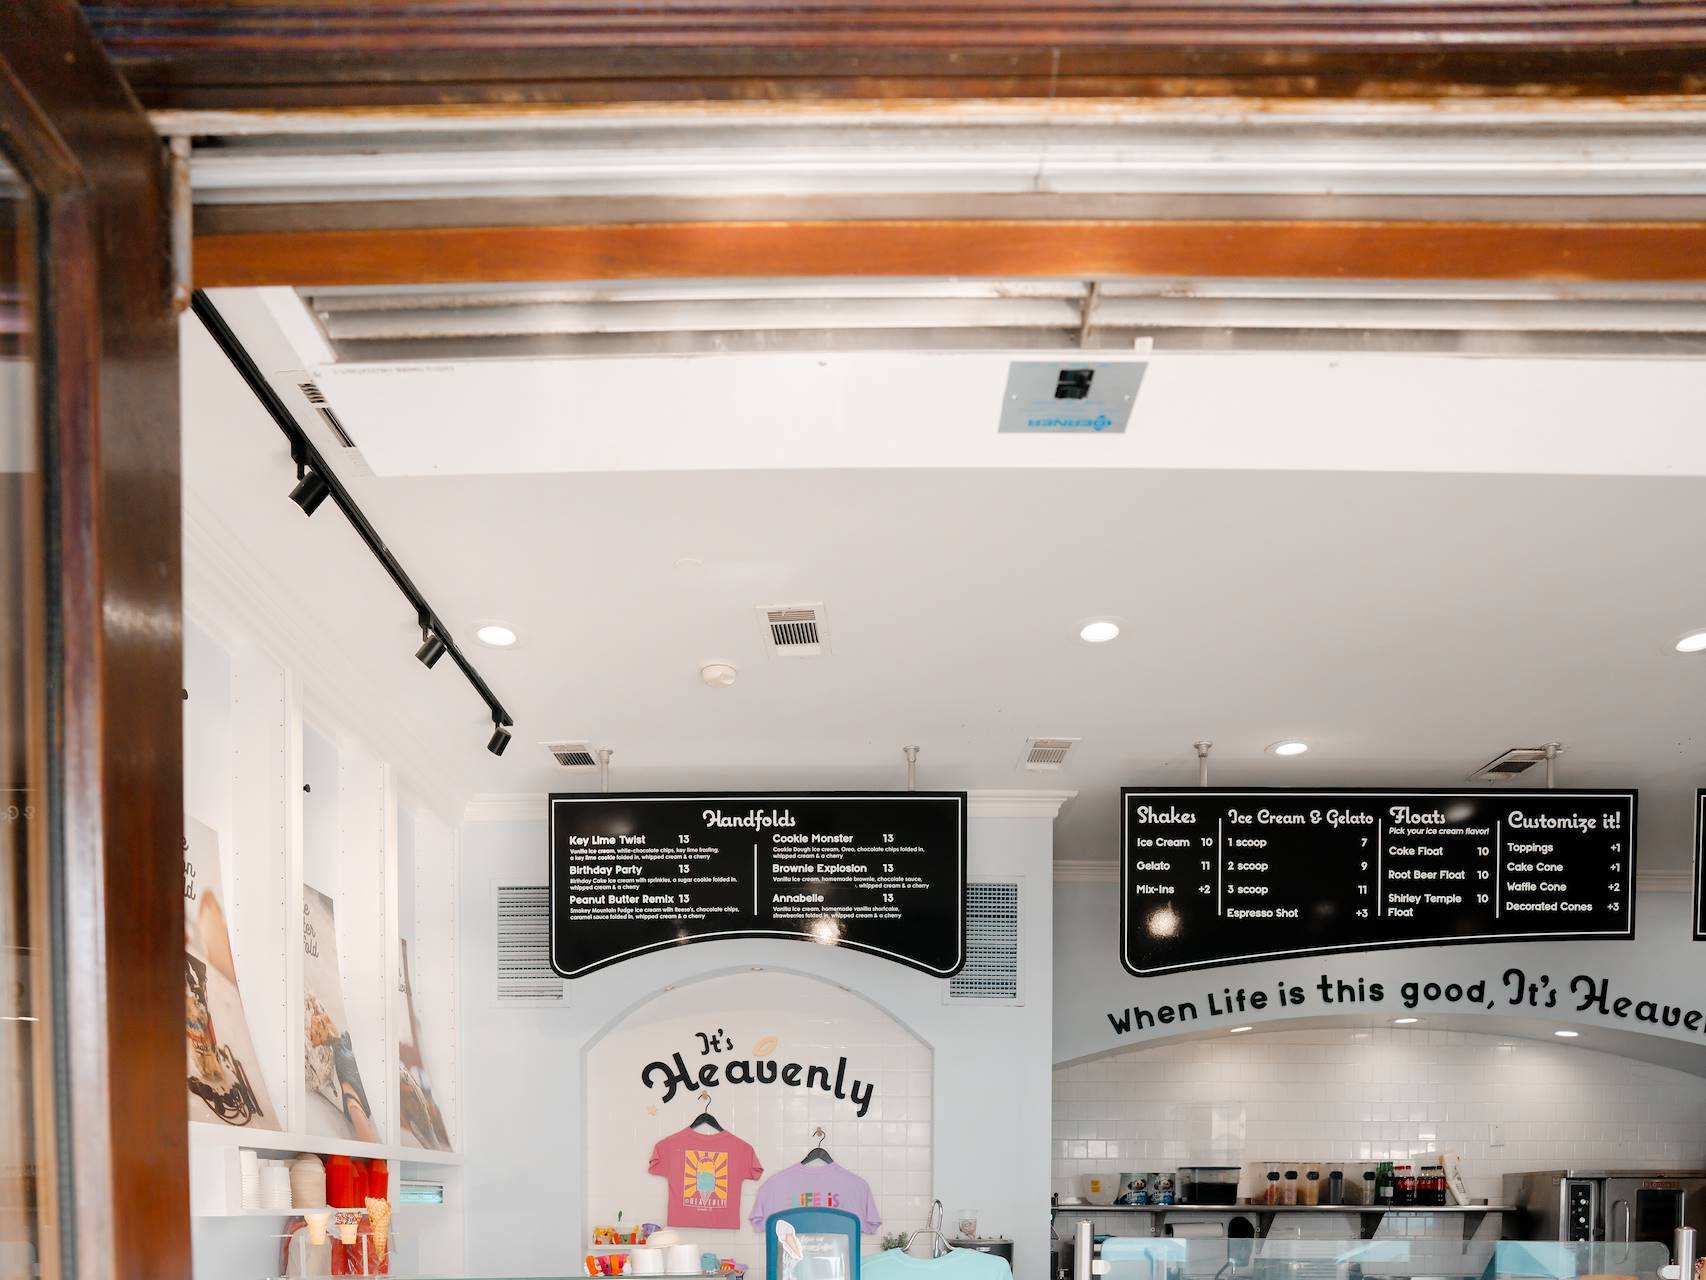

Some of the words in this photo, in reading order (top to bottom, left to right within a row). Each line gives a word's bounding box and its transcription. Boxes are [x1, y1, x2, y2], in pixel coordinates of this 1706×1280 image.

[1137, 806, 1196, 823] Shakes
[1228, 809, 1252, 824] Ice
[1258, 809, 1305, 824] Cream
[1310, 810, 1322, 824] &
[1327, 809, 1373, 828] Gelato
[1390, 806, 1446, 825] Floats
[703, 810, 795, 832] Handfolds
[1508, 811, 1596, 833] Customize
[1603, 811, 1620, 829] it!
[570, 836, 589, 847] Key
[592, 836, 616, 846] Lime
[619, 835, 645, 844] Twist
[679, 835, 689, 843] 13
[773, 834, 808, 843] Cookie
[812, 834, 853, 843] Monster
[883, 834, 894, 842] 13
[1137, 838, 1153, 847] Ice
[1156, 838, 1190, 846] Cream
[1201, 838, 1213, 846] 10
[1228, 838, 1232, 846] 1
[1236, 839, 1267, 848] scoop
[1362, 838, 1367, 847] 7
[1389, 846, 1415, 855] Coke
[1418, 847, 1443, 856] Float
[1478, 847, 1489, 856] 10
[1507, 843, 1553, 855] Toppings
[1611, 844, 1620, 852] +1
[570, 866, 612, 876] Birthday
[616, 865, 642, 875] Party
[679, 865, 690, 873] 13
[773, 864, 814, 873] Brownie
[817, 864, 867, 874] Explosion
[883, 864, 894, 872] 13
[1137, 861, 1170, 870] Gelato
[1201, 861, 1210, 870] 11
[1228, 861, 1234, 870] 2
[1238, 863, 1268, 872] scoop
[1361, 862, 1367, 870] 9
[1507, 862, 1533, 871] Cake
[1536, 863, 1563, 871] Cone
[1611, 863, 1620, 872] +1
[1389, 870, 1411, 879] Root
[1414, 870, 1437, 879] Beer
[1440, 870, 1465, 879] Float
[1477, 871, 1489, 879] 10
[1199, 885, 1210, 894] +2
[1228, 885, 1234, 893] 3
[1238, 887, 1268, 896] scoop
[1358, 885, 1367, 894] 11
[1507, 882, 1537, 891] Waffle
[1540, 882, 1567, 891] Cone
[1608, 883, 1620, 891] +2
[570, 895, 605, 904] Peanut
[608, 895, 639, 904] Butter
[643, 895, 674, 903] Remix
[679, 894, 689, 903] 13
[773, 894, 824, 902] Annabelle
[883, 894, 894, 902] 13
[1389, 894, 1421, 904] Shirley
[1424, 894, 1462, 904] Temple
[1477, 894, 1489, 903] 10
[1506, 902, 1557, 911] Decorated
[1560, 902, 1592, 911] Cones
[1608, 903, 1619, 911] +3
[1227, 908, 1273, 919] Espresso
[1276, 908, 1298, 917] Shot
[1356, 909, 1368, 918] +3
[1388, 908, 1413, 917] Float
[1108, 1002, 1197, 1035] When
[1208, 988, 1268, 1016] Life
[1278, 981, 1305, 1006] is
[1317, 975, 1384, 1003] this
[1400, 980, 1495, 1009] good,
[1502, 968, 1557, 1008] It's
[1570, 974, 1706, 1033] Heave
[695, 1028, 733, 1055] It's
[641, 1052, 874, 1118] Heavenly
